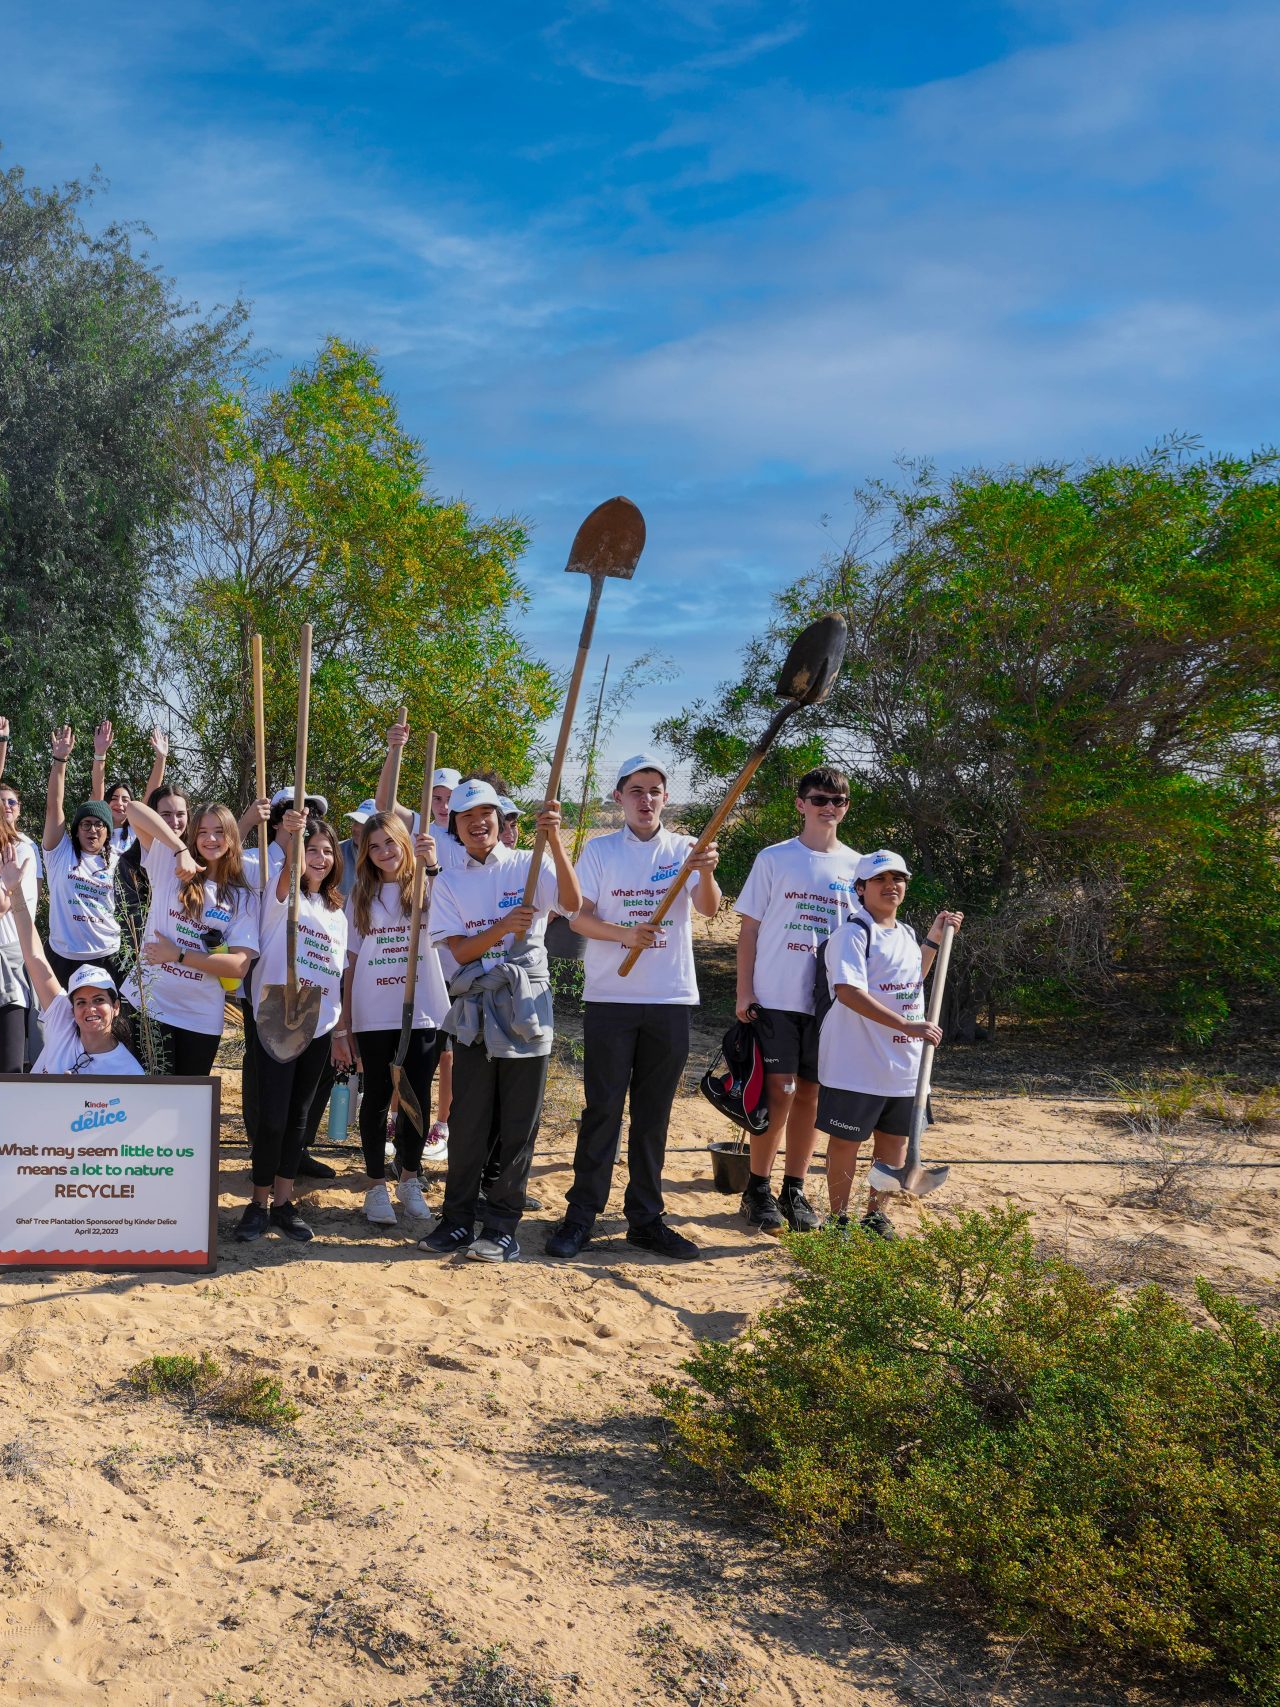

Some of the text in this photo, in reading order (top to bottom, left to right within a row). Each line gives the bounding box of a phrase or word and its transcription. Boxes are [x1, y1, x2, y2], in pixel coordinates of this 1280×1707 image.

[651, 869, 678, 882] delic
[636, 889, 654, 897] may
[785, 891, 808, 899] What
[809, 893, 828, 904] may
[624, 899, 642, 907] little
[796, 902, 815, 910] little
[205, 909, 230, 922] delic
[800, 914, 828, 924] means
[407, 923, 426, 931] sm
[304, 937, 319, 948] little
[315, 932, 331, 943] may
[376, 936, 394, 944] little
[176, 937, 200, 949] means
[382, 946, 409, 954] means
[309, 962, 318, 970] to
[161, 962, 203, 981] RECYCLE!
[377, 975, 418, 986] RECYC!
[879, 983, 906, 991] What
[896, 992, 912, 1000] little
[41, 1146, 75, 1160] may
[77, 1146, 118, 1157] seem
[121, 1144, 154, 1157] little
[157, 1145, 173, 1157] to
[176, 1147, 194, 1158] us
[17, 1163, 174, 1176] means a lot to nature
[54, 1184, 135, 1199] RECYCLE!
[86, 1218, 123, 1226] Sponsored
[125, 1218, 133, 1226] by
[74, 1228, 119, 1236] April 22,2023
